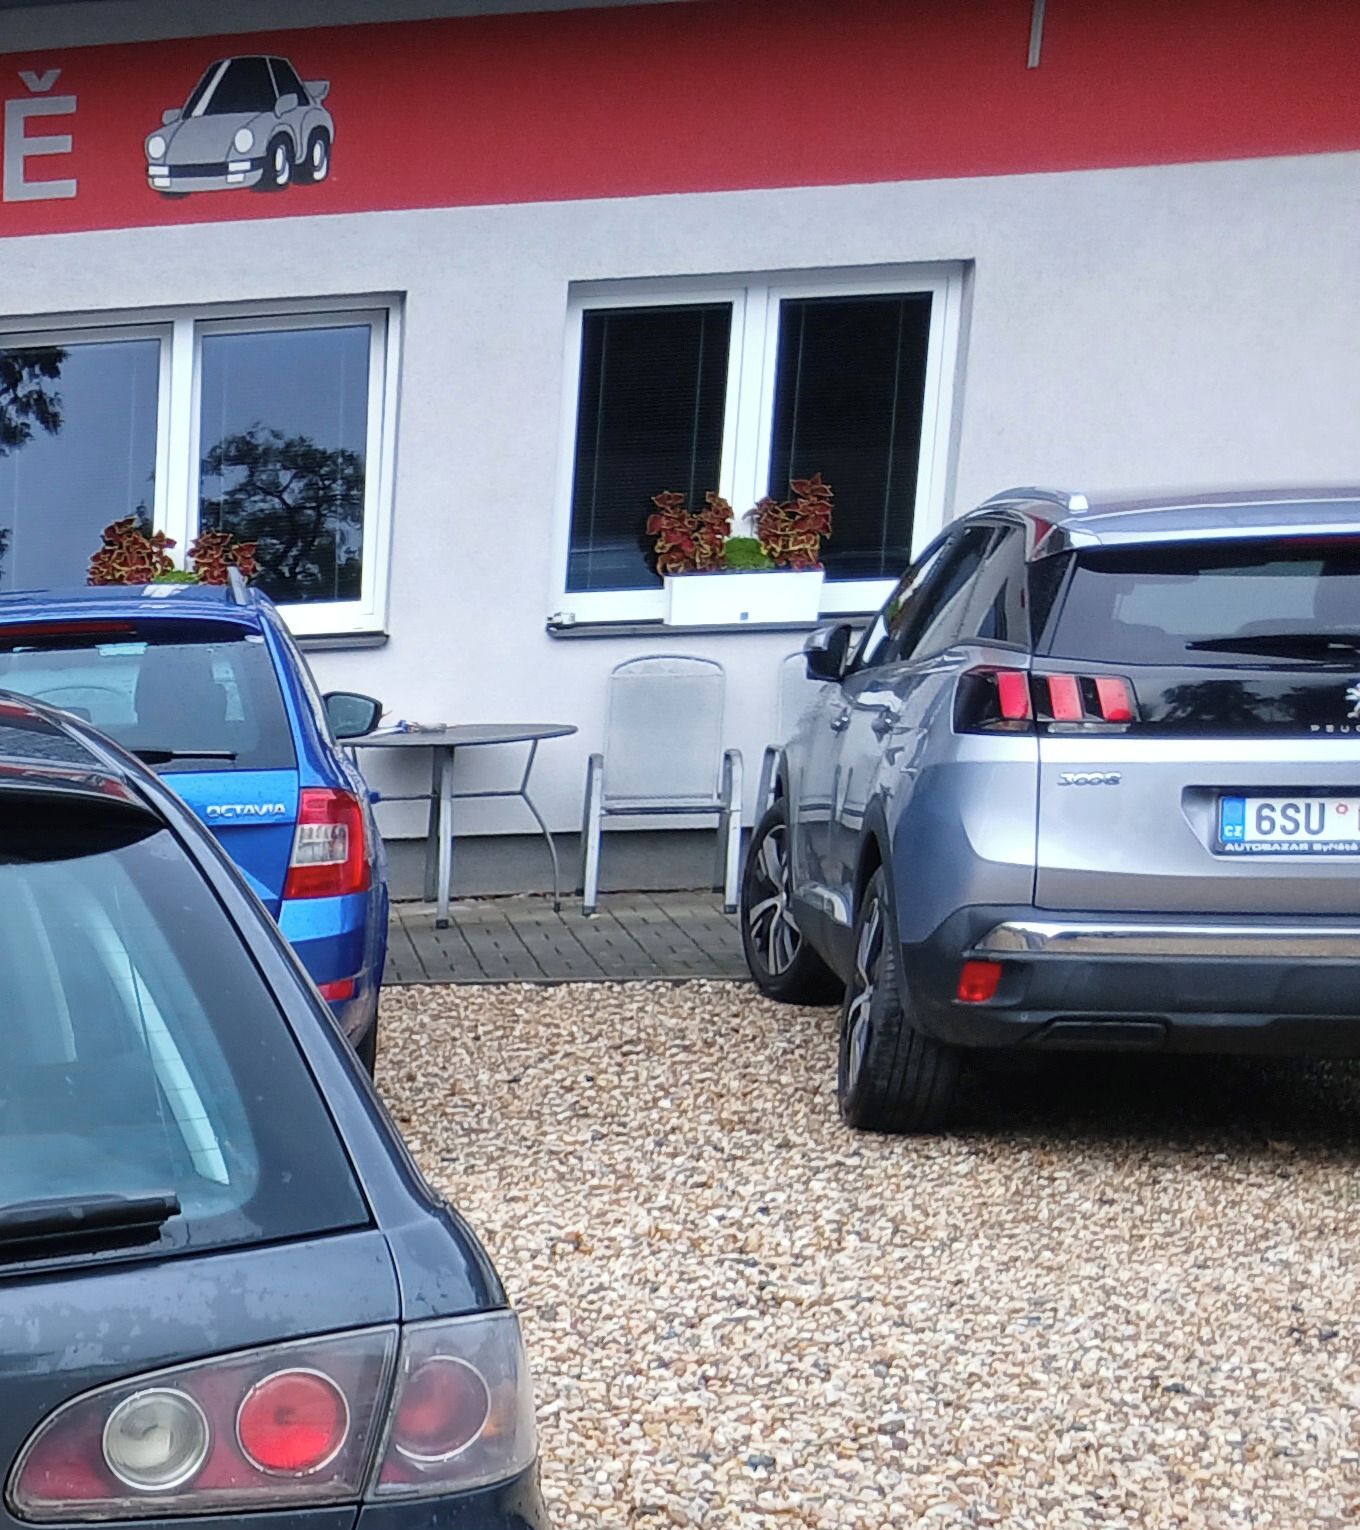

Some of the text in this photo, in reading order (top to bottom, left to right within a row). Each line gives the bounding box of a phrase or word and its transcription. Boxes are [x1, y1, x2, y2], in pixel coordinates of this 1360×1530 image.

[206, 803, 286, 817] OCTAVIA
[1255, 802, 1326, 836] 6SU
[1223, 825, 1243, 837] CZ
[1224, 842, 1309, 851] AUTOBAZAR
